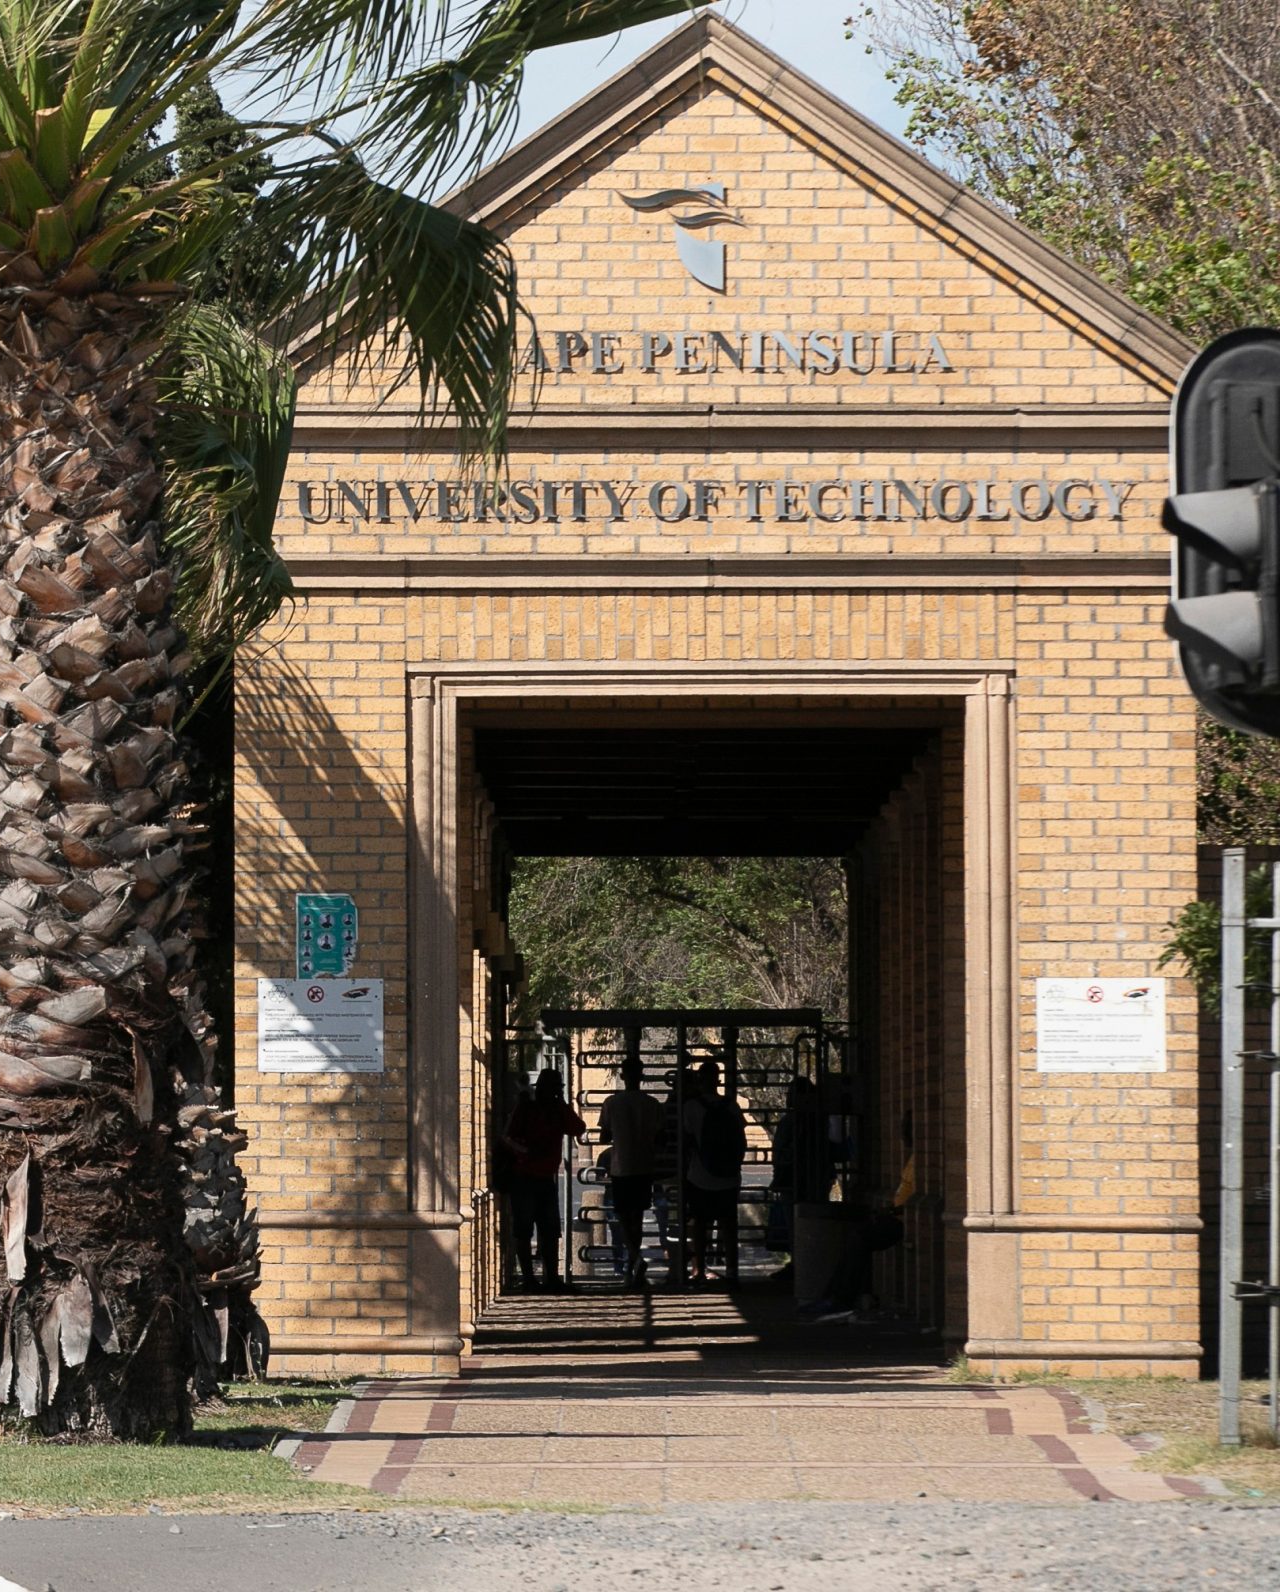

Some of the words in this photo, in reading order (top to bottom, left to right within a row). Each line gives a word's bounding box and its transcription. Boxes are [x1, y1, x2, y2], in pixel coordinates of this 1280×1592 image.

[478, 330, 624, 374] APE
[641, 329, 956, 375] PENINSULA
[297, 479, 636, 525] UNIVERSITY
[648, 479, 726, 524] OF
[739, 478, 1137, 524] TECHNOLOGY
